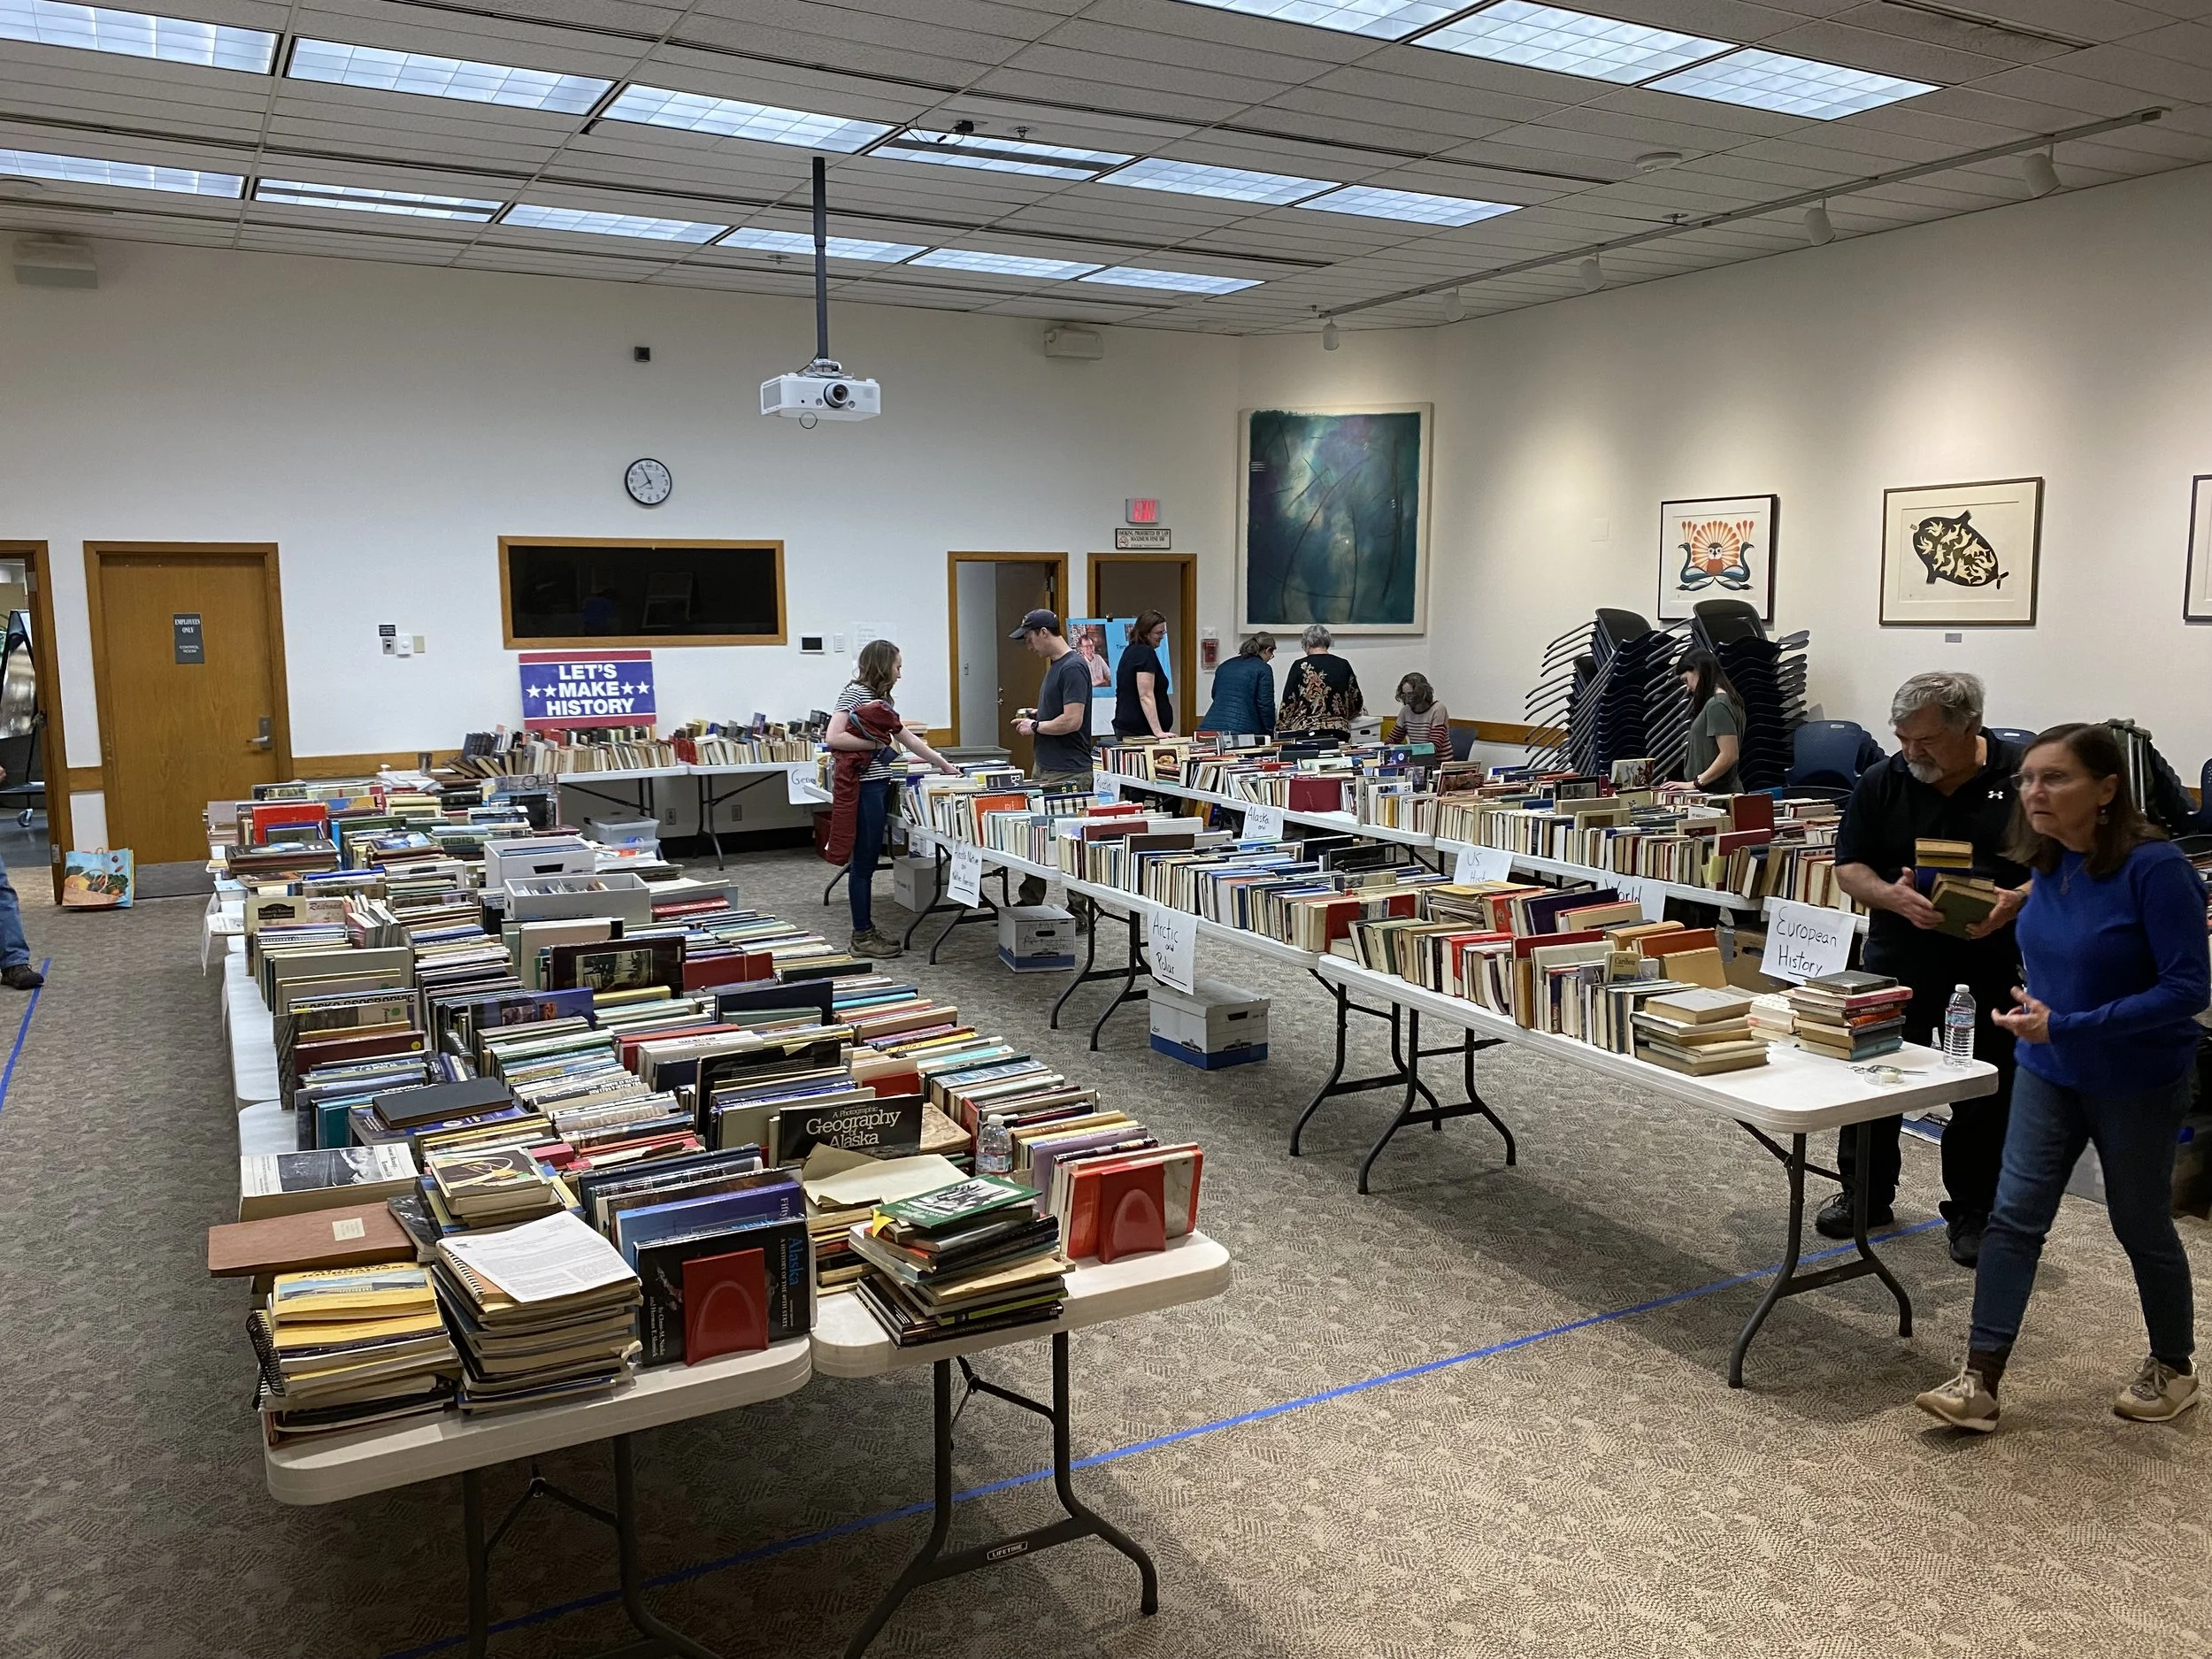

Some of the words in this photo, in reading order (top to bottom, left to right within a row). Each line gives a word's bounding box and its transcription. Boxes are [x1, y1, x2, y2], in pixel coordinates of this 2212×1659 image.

[1134, 500, 1156, 521] EXIT
[558, 664, 618, 680] LET'S
[558, 681, 619, 698] MAKE
[545, 697, 635, 717] HISTORY
[1246, 805, 1270, 825] Alaska
[1467, 852, 1482, 867] US
[1604, 878, 1642, 902] World
[1152, 910, 1179, 944] Arctic
[1776, 905, 1838, 948] European
[1164, 943, 1174, 952] and
[1156, 951, 1175, 975] Polar
[1778, 944, 1824, 977] History
[806, 1109, 902, 1135] Geography
[840, 1106, 879, 1118] Photographic
[829, 1131, 879, 1149] Alaska
[849, 1127, 857, 1137] of
[788, 1238, 803, 1286] Alaska
[781, 1271, 787, 1279] OF
[992, 1544, 1023, 1557] LIFETIME
